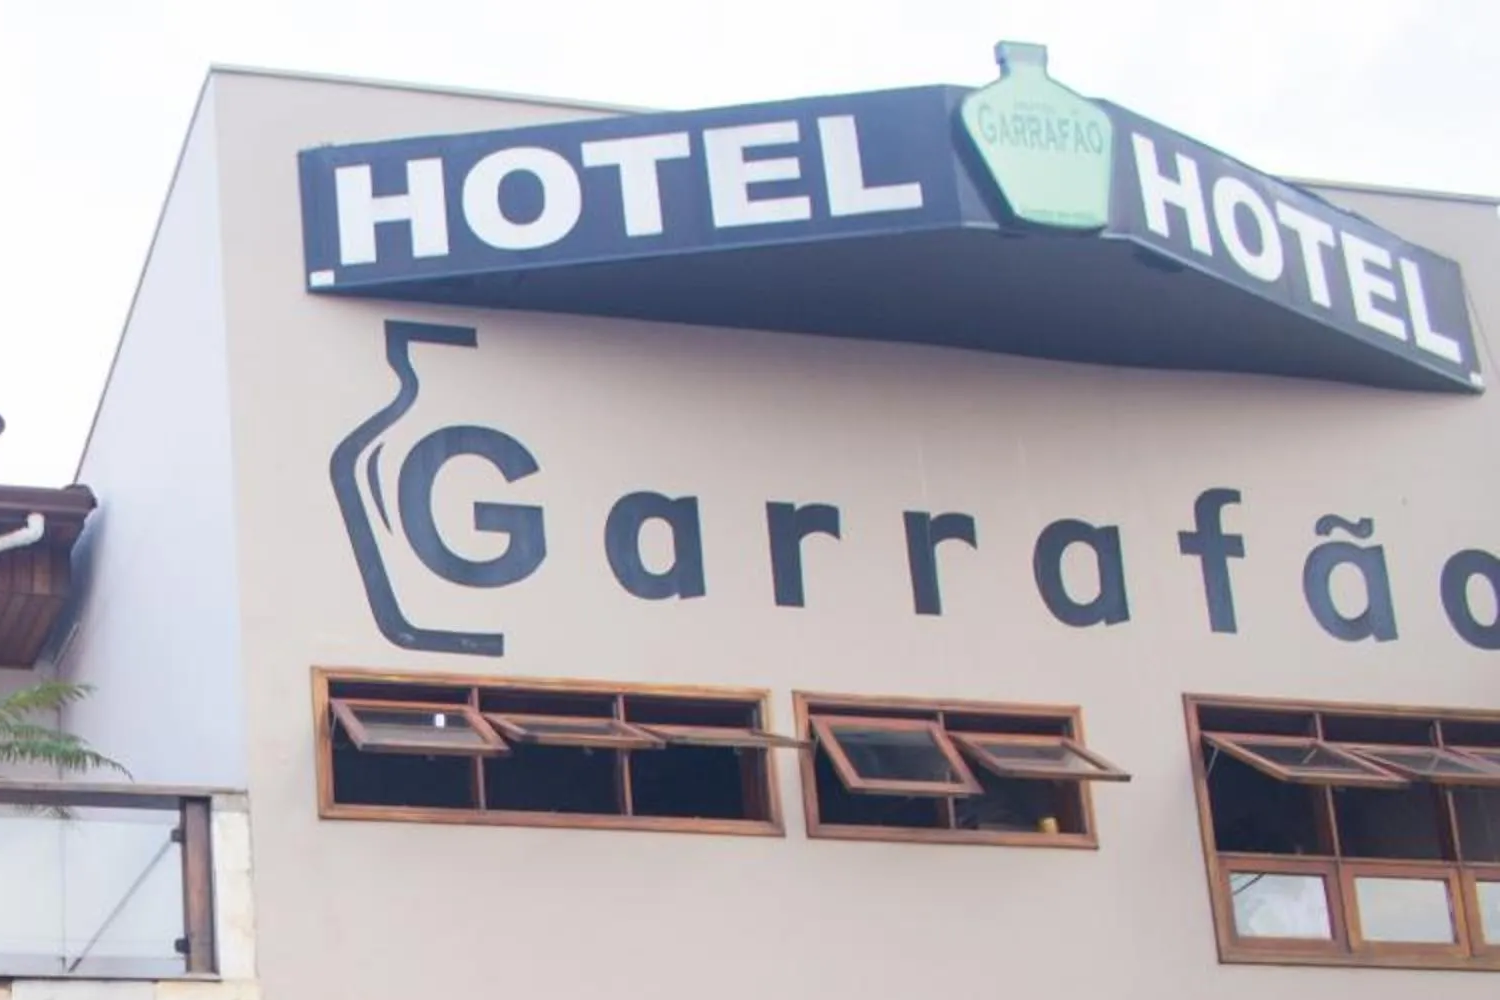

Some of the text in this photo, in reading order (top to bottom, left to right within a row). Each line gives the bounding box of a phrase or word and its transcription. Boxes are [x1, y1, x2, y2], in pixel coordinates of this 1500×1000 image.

[334, 114, 924, 266] HOTEL
[1132, 131, 1463, 364] HOTEL
[398, 424, 1500, 652] Garrafão
